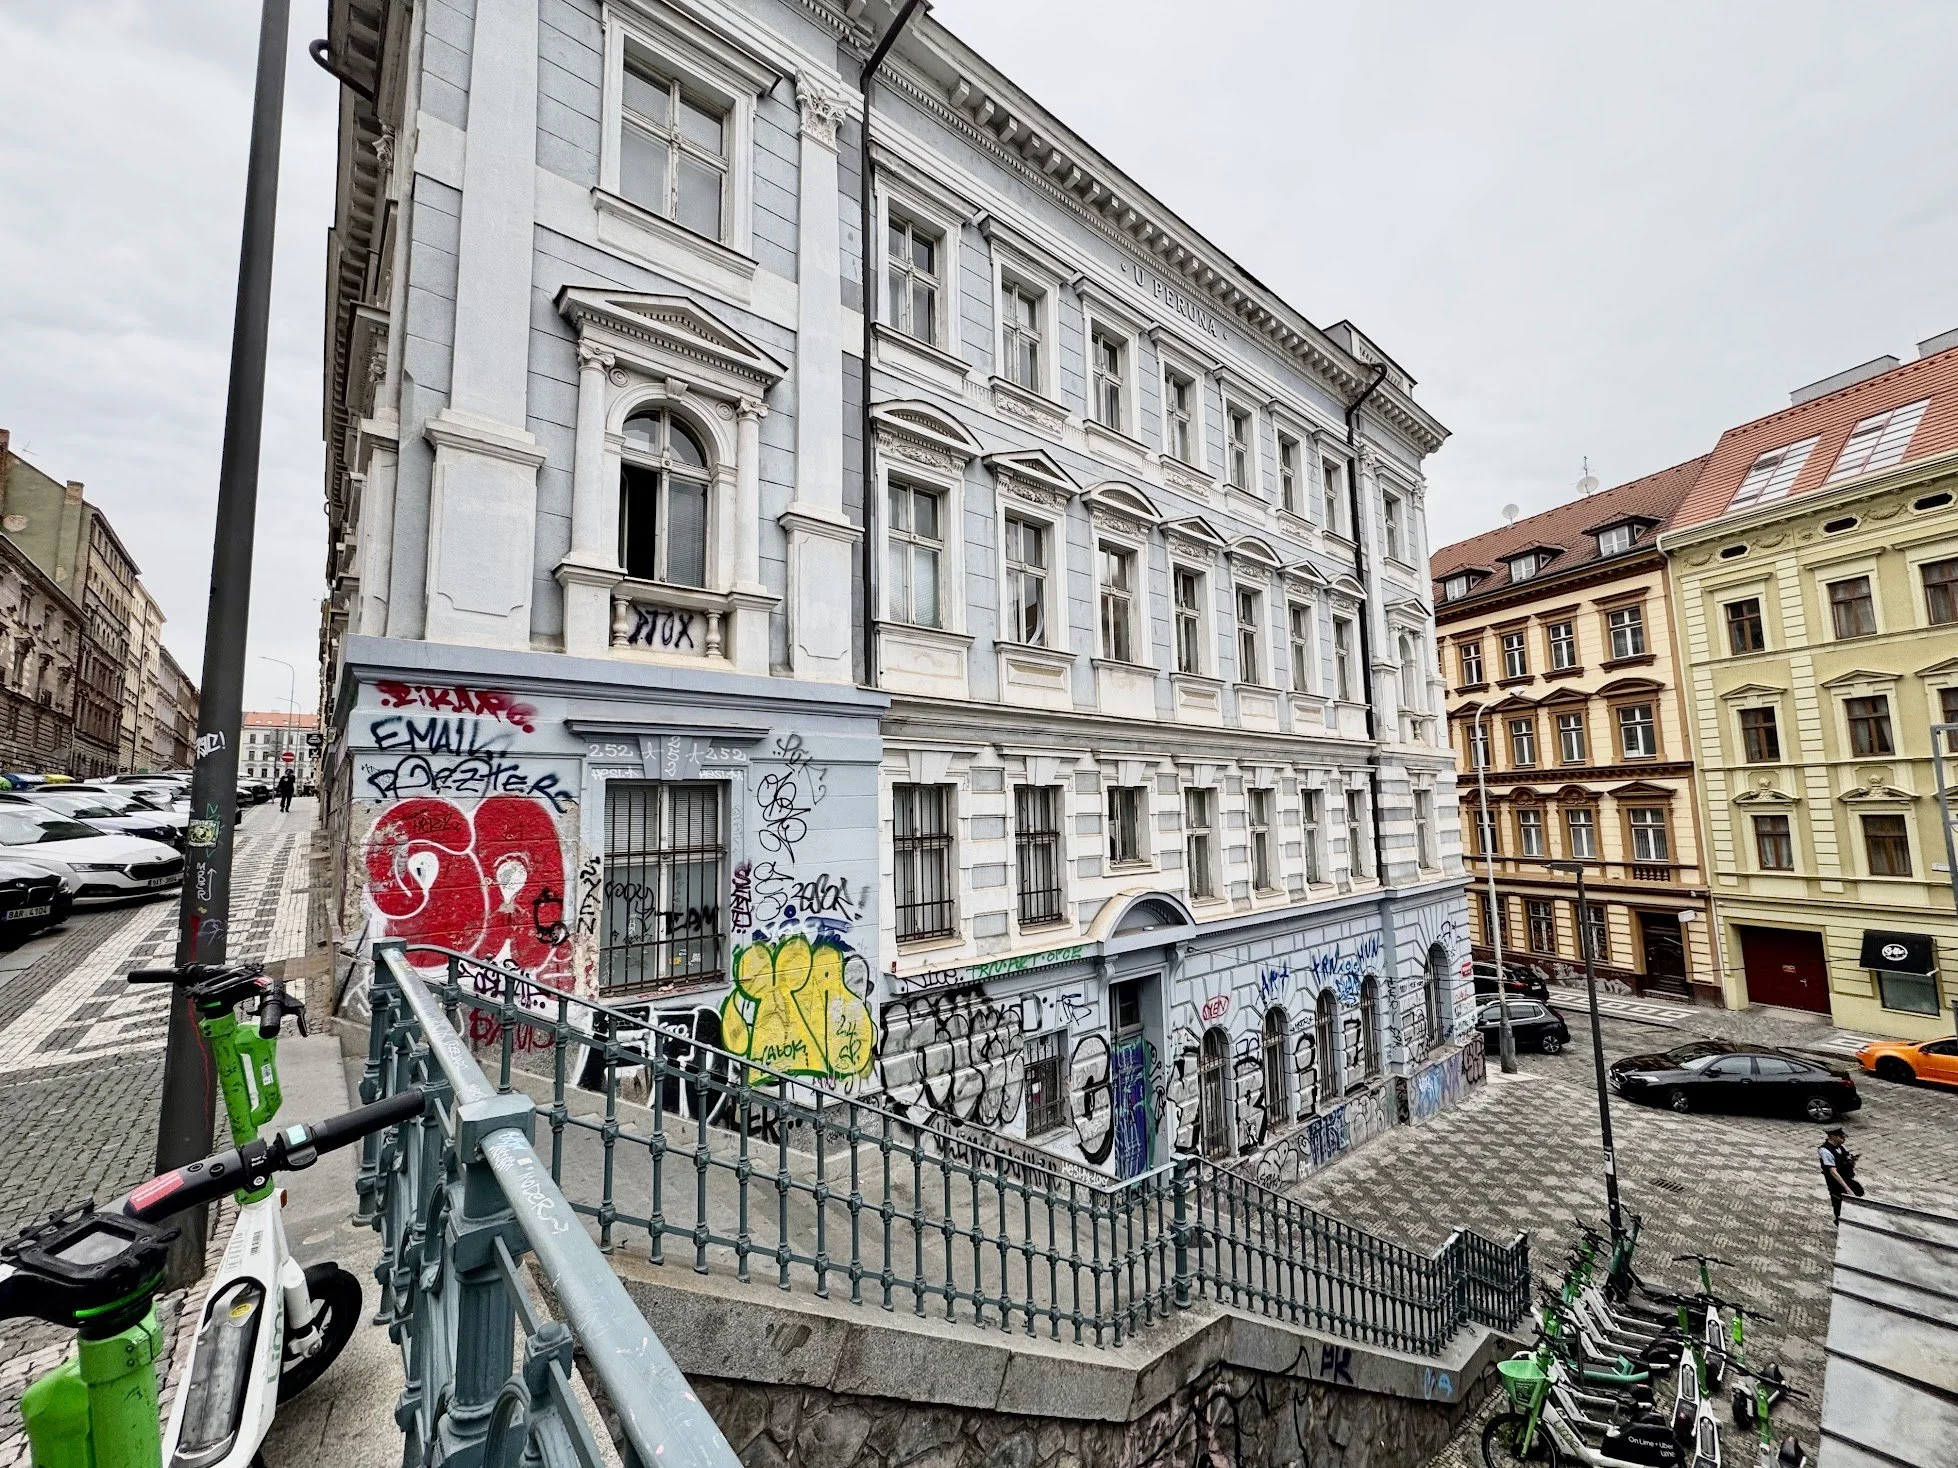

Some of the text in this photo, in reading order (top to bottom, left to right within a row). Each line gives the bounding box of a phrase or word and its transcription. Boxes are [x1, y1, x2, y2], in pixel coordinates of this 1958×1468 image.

[1133, 264, 1218, 338] U PERUNA
[589, 744, 634, 758] 252
[704, 747, 747, 762] 252
[29, 907, 47, 916] 4104
